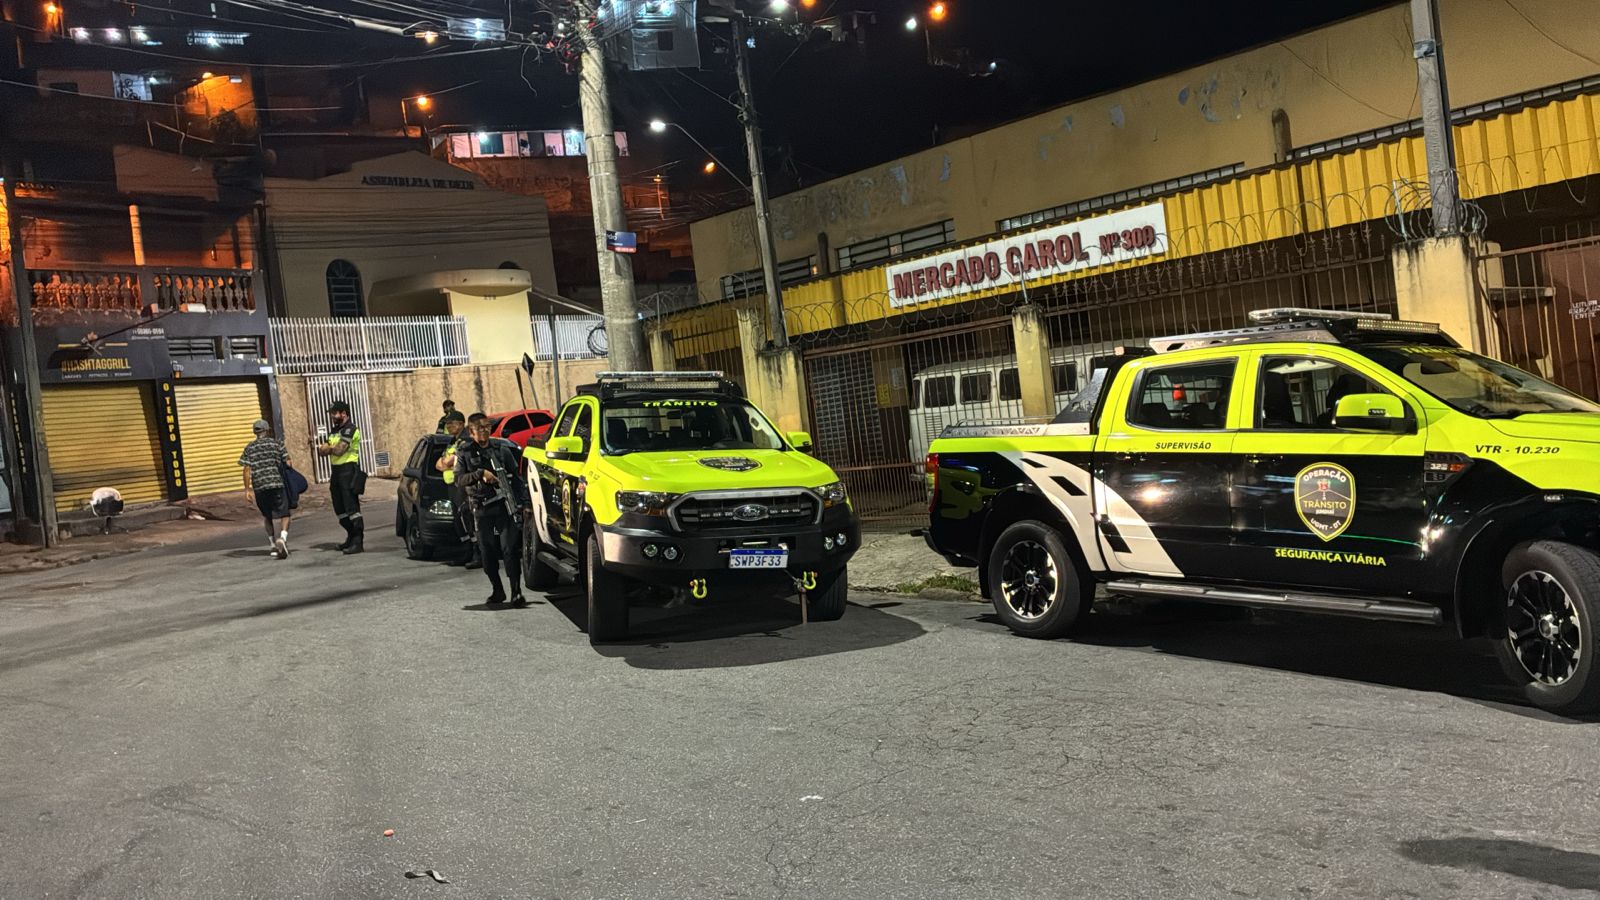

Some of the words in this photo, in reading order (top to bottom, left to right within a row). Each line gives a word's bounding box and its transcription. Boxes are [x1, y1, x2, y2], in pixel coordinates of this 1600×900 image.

[892, 250, 1001, 300] MERCADO
[1005, 231, 1089, 276] CAROL
[162, 382, 170, 392] O
[164, 396, 177, 442] TEMPO
[1155, 441, 1212, 450] SUPERVISÃO
[1475, 444, 1502, 454] VTR
[1514, 446, 1560, 454] 10.230
[171, 450, 182, 487] TODO
[1303, 469, 1347, 483] OPERAÇÃO
[1303, 499, 1347, 510] TRÂNSITO
[734, 555, 782, 567] SWP3F33
[1275, 548, 1342, 563] SEGURANÇA
[1344, 552, 1387, 567] VIÁRIA
